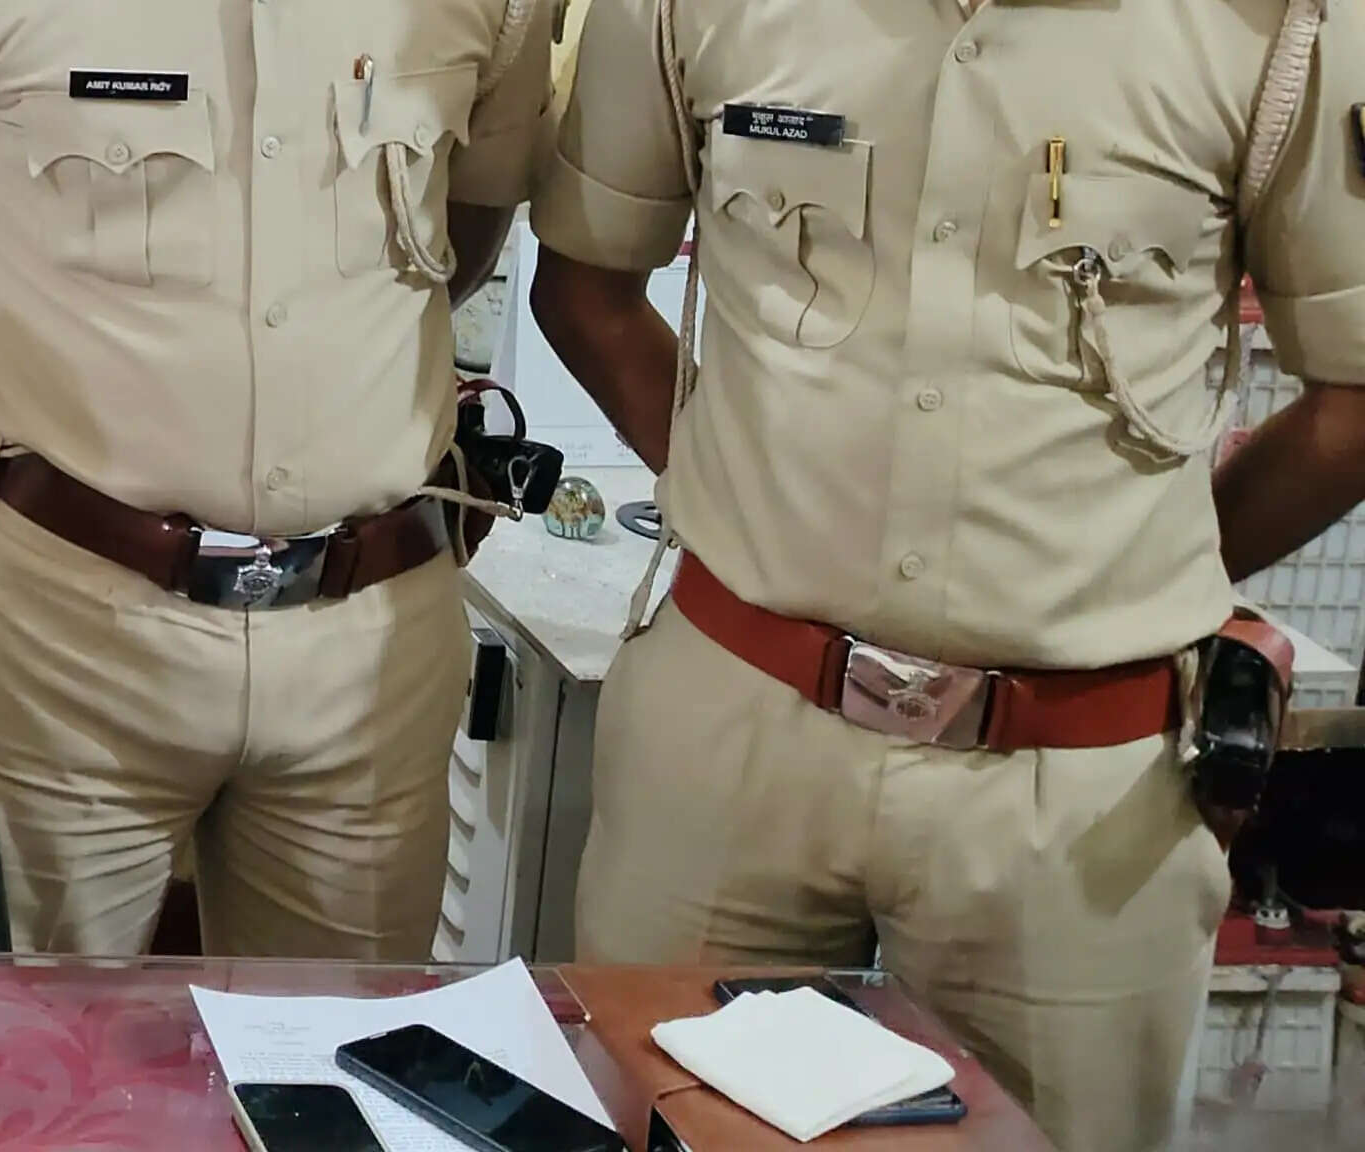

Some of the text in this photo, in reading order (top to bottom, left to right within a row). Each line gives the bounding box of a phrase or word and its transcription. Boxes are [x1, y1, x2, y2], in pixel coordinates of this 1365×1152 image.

[112, 81, 148, 90] KUMAR
[749, 125, 808, 138] MUKUL AZAD
